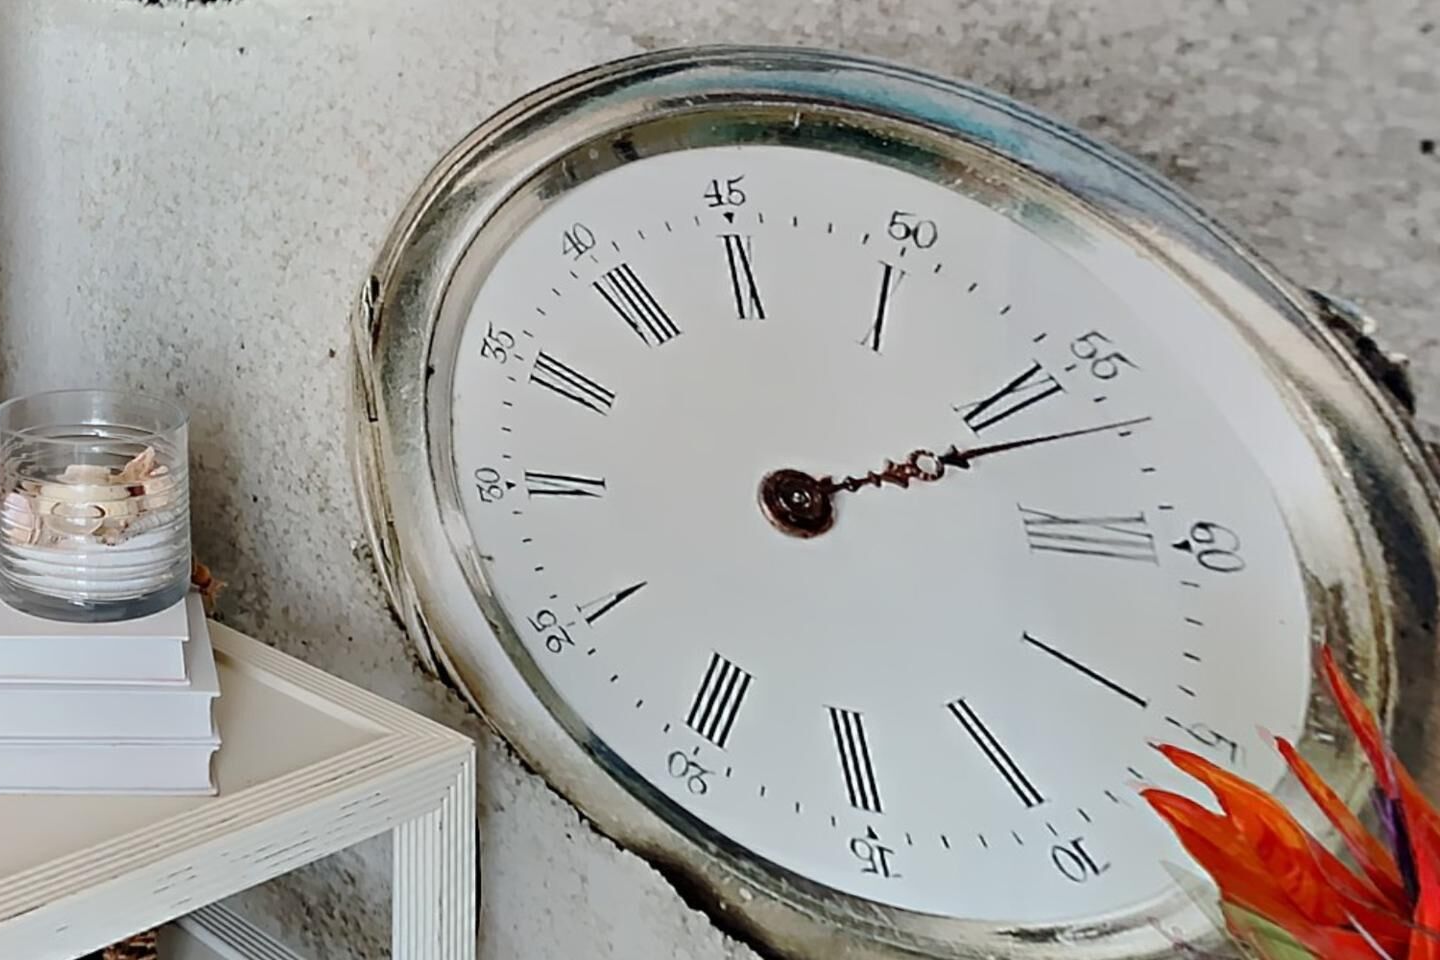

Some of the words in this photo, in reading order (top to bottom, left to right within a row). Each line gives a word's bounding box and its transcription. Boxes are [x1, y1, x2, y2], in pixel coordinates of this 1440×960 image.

[703, 176, 747, 207] 45
[561, 222, 596, 261] 40
[887, 210, 939, 250] 50
[480, 321, 515, 364] 35
[1069, 330, 1141, 381] 55
[474, 467, 505, 503] 30
[1189, 520, 1246, 574] 60
[527, 609, 576, 654] 25
[667, 749, 717, 795] 20
[849, 836, 903, 878] 15
[1051, 837, 1110, 883] 10
